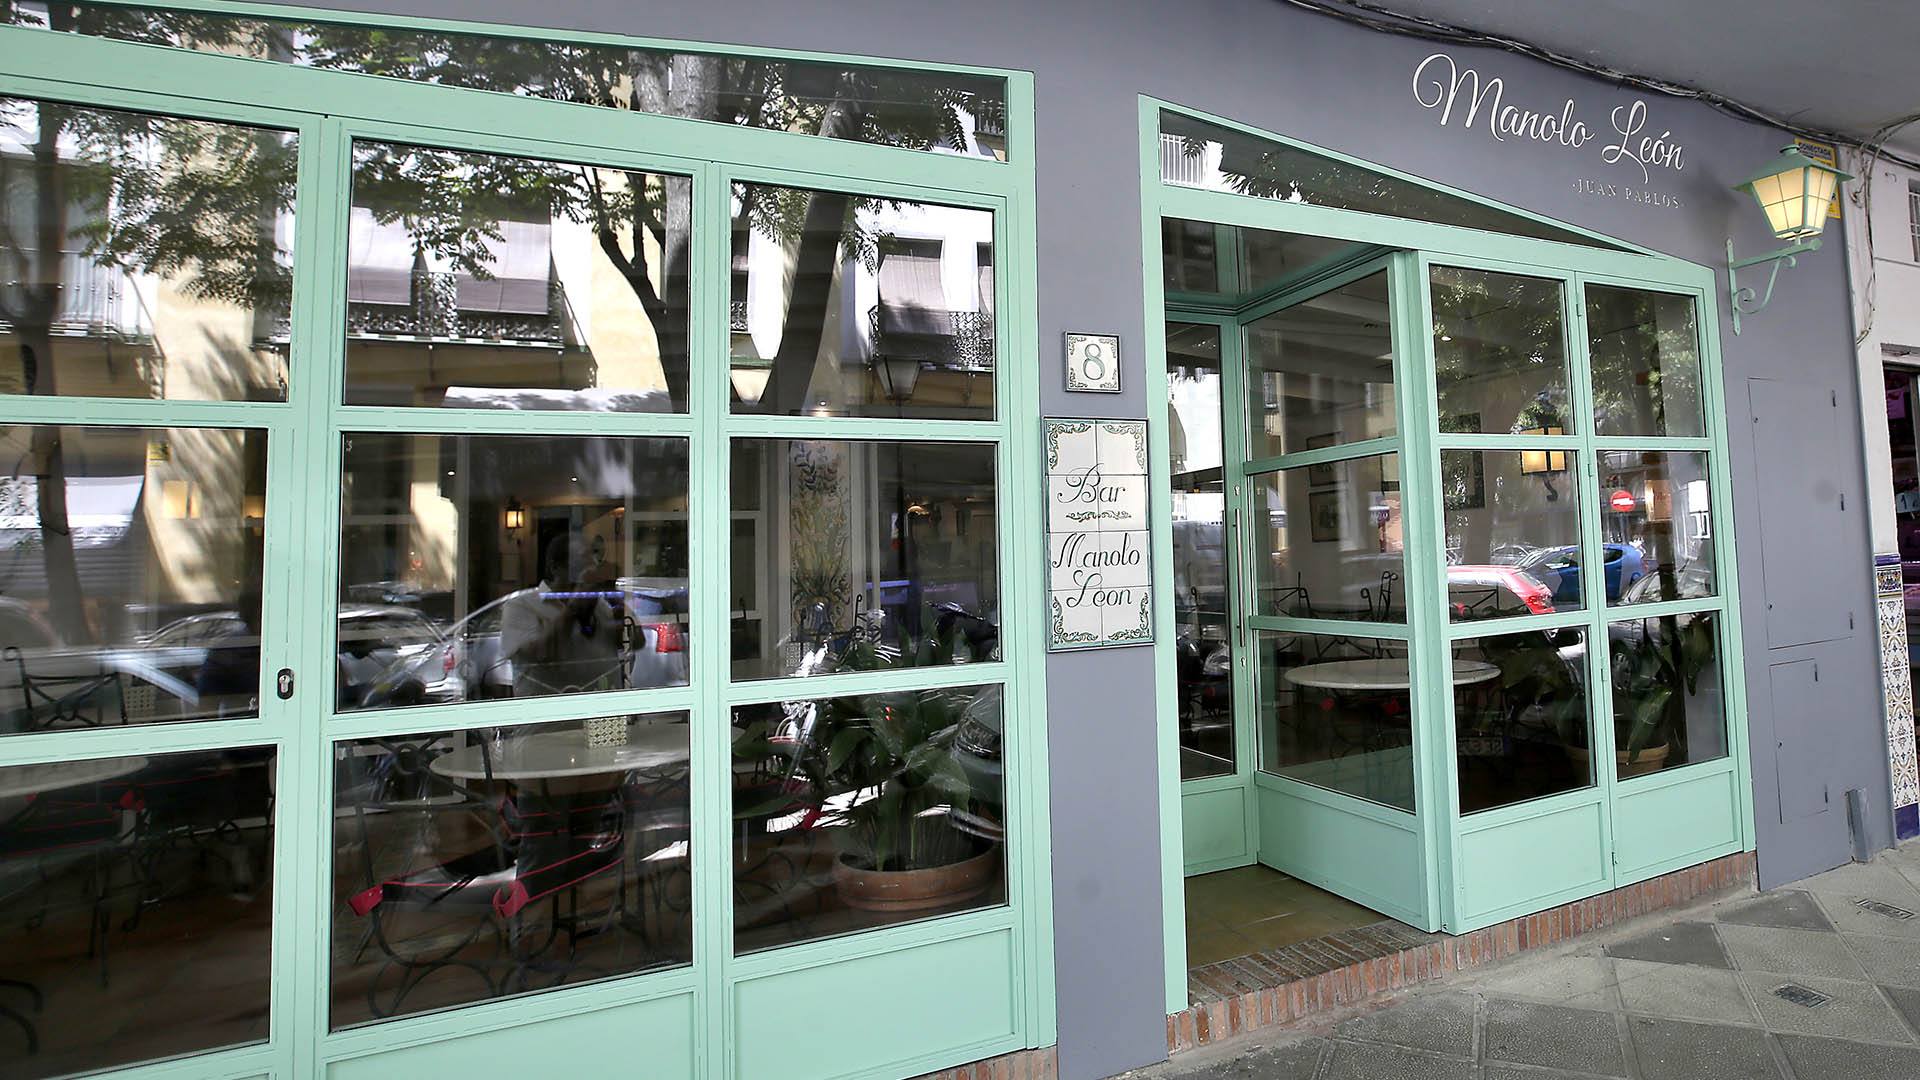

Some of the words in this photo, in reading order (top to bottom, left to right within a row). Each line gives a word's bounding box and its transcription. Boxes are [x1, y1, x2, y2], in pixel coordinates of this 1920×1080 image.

[1412, 53, 1595, 148] Manolo
[1601, 100, 1684, 184] León
[1578, 179, 1616, 197] JUAN
[1625, 187, 1679, 209] PABLOS
[1083, 343, 1106, 381] 8
[1057, 463, 1126, 503] Bar
[1052, 532, 1140, 569] Manolo
[1066, 569, 1132, 608] Leon
